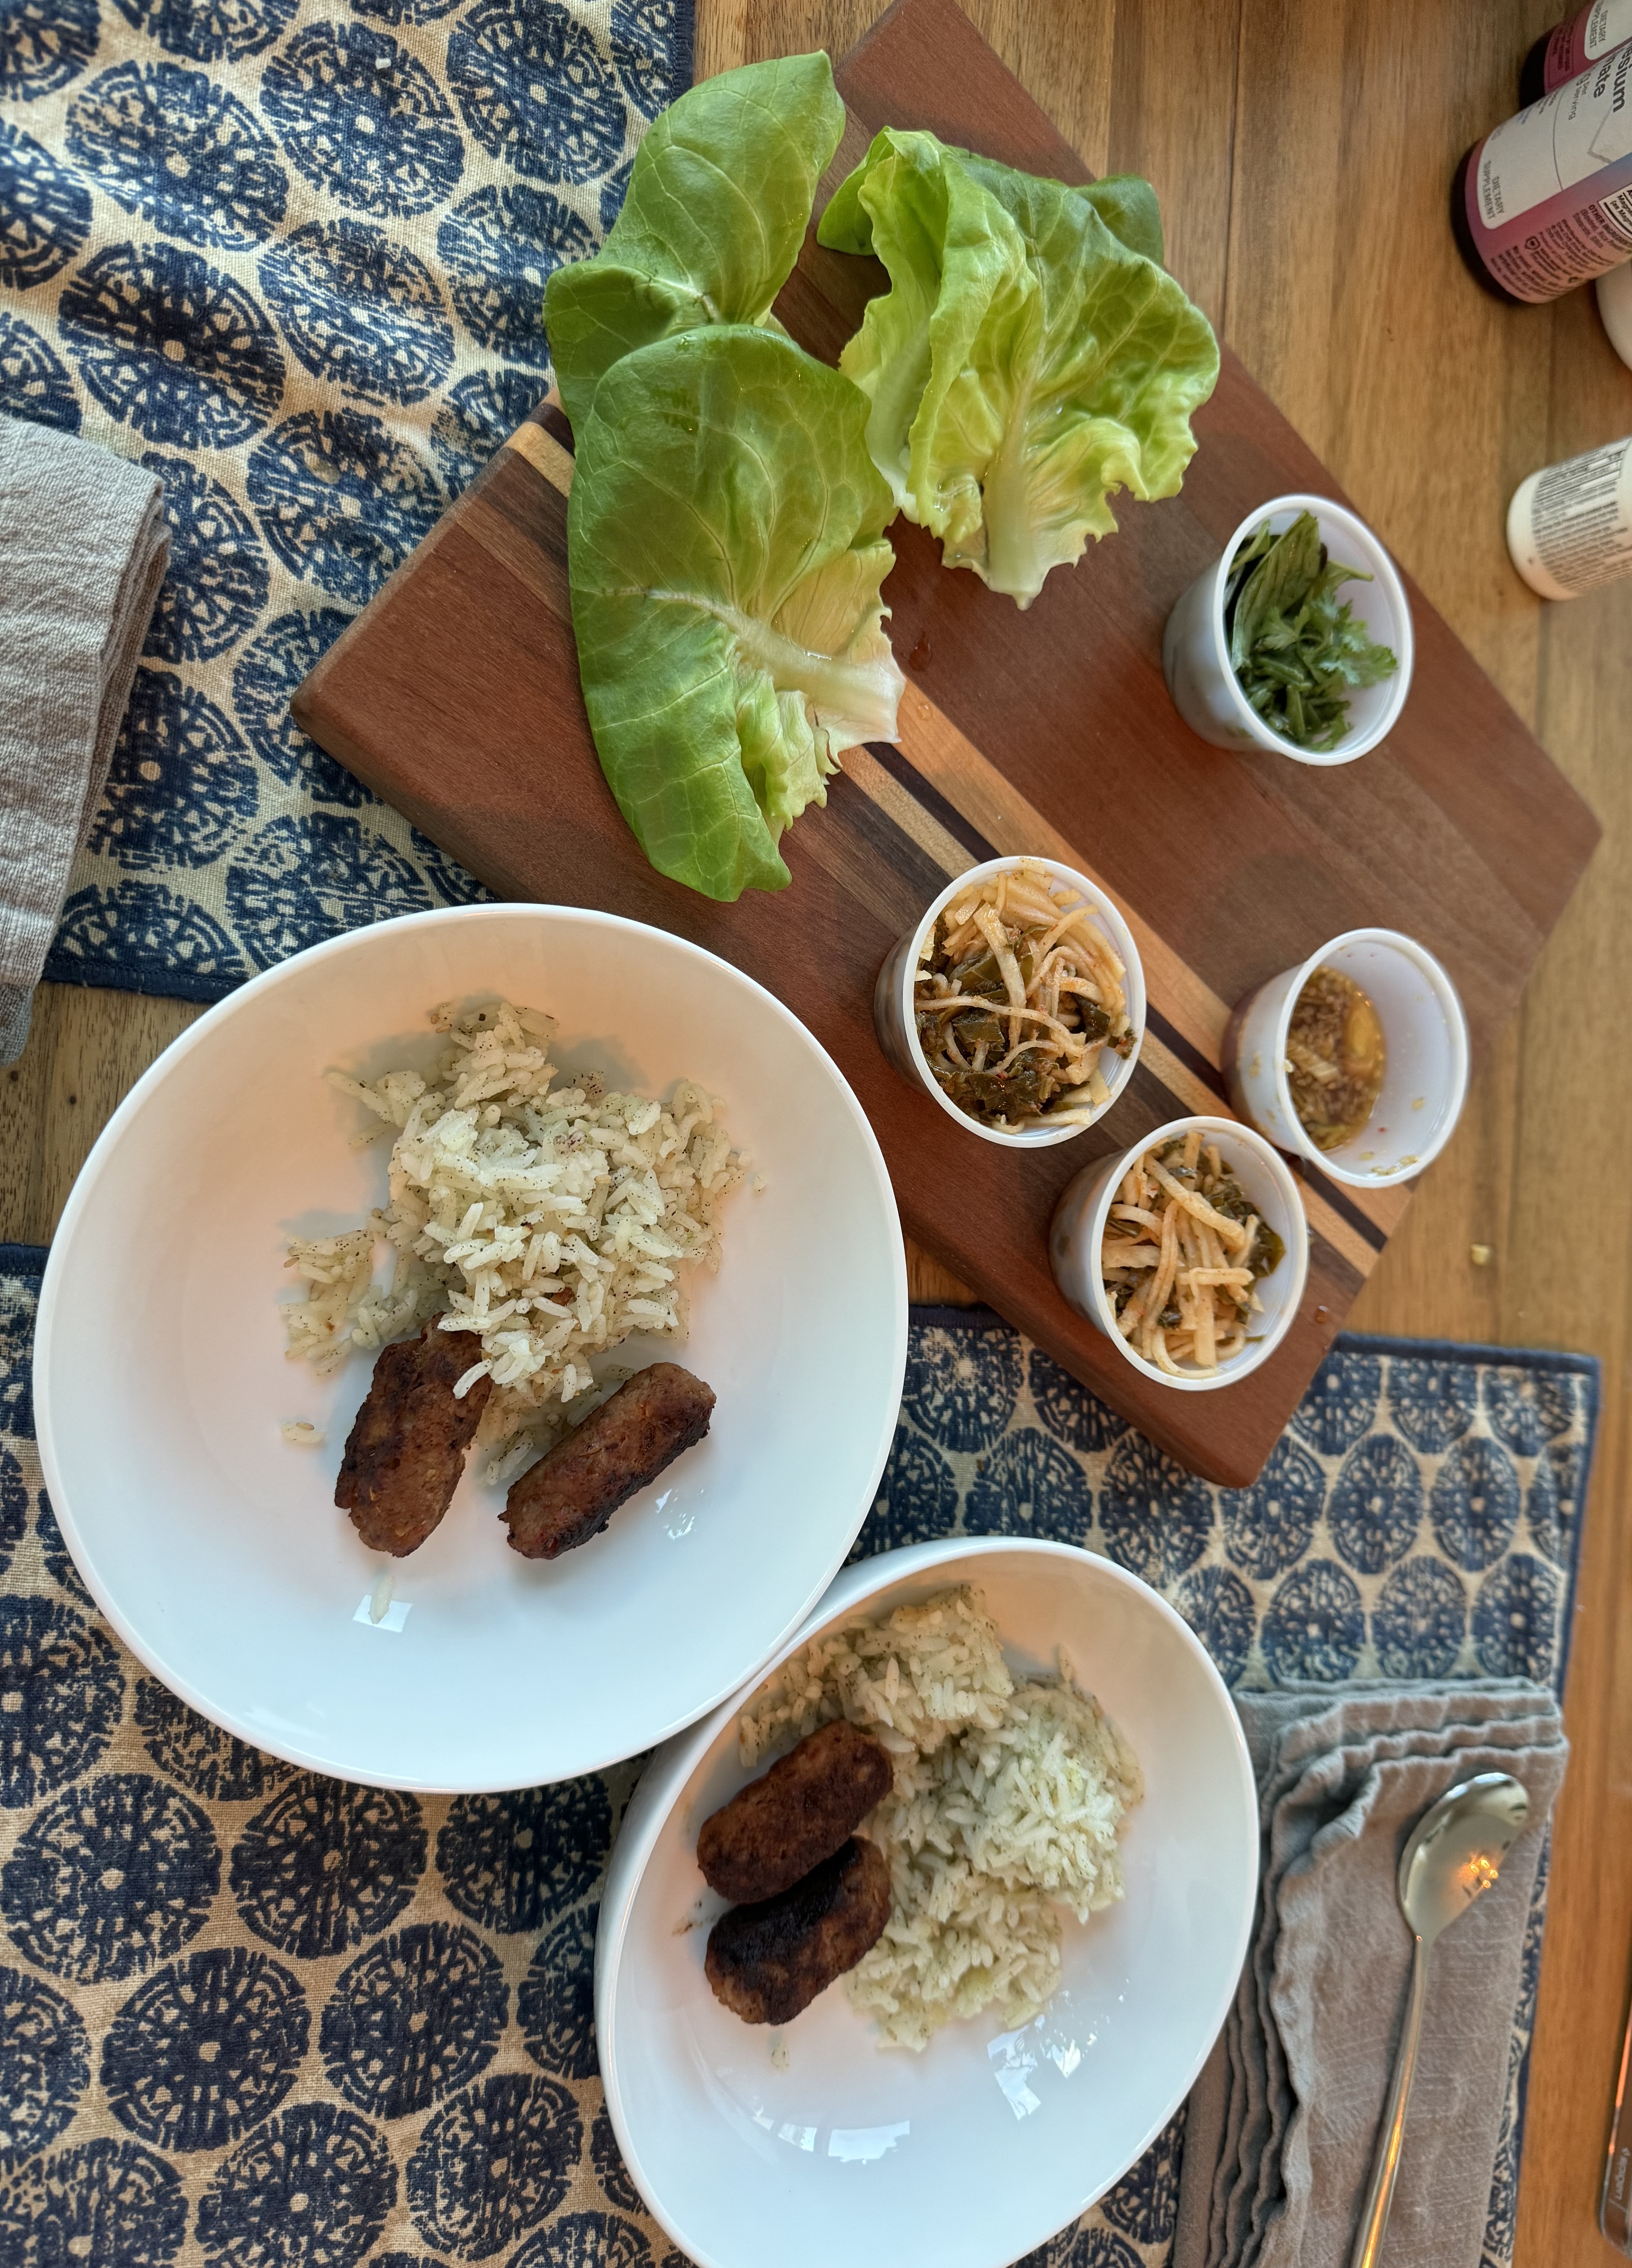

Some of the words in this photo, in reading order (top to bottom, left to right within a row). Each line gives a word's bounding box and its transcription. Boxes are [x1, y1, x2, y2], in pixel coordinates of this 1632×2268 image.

[1483, 160, 1496, 219] SUPPLEMENT
[1492, 176, 1505, 214] DIETARY
[1588, 204, 1605, 225] OTHER
